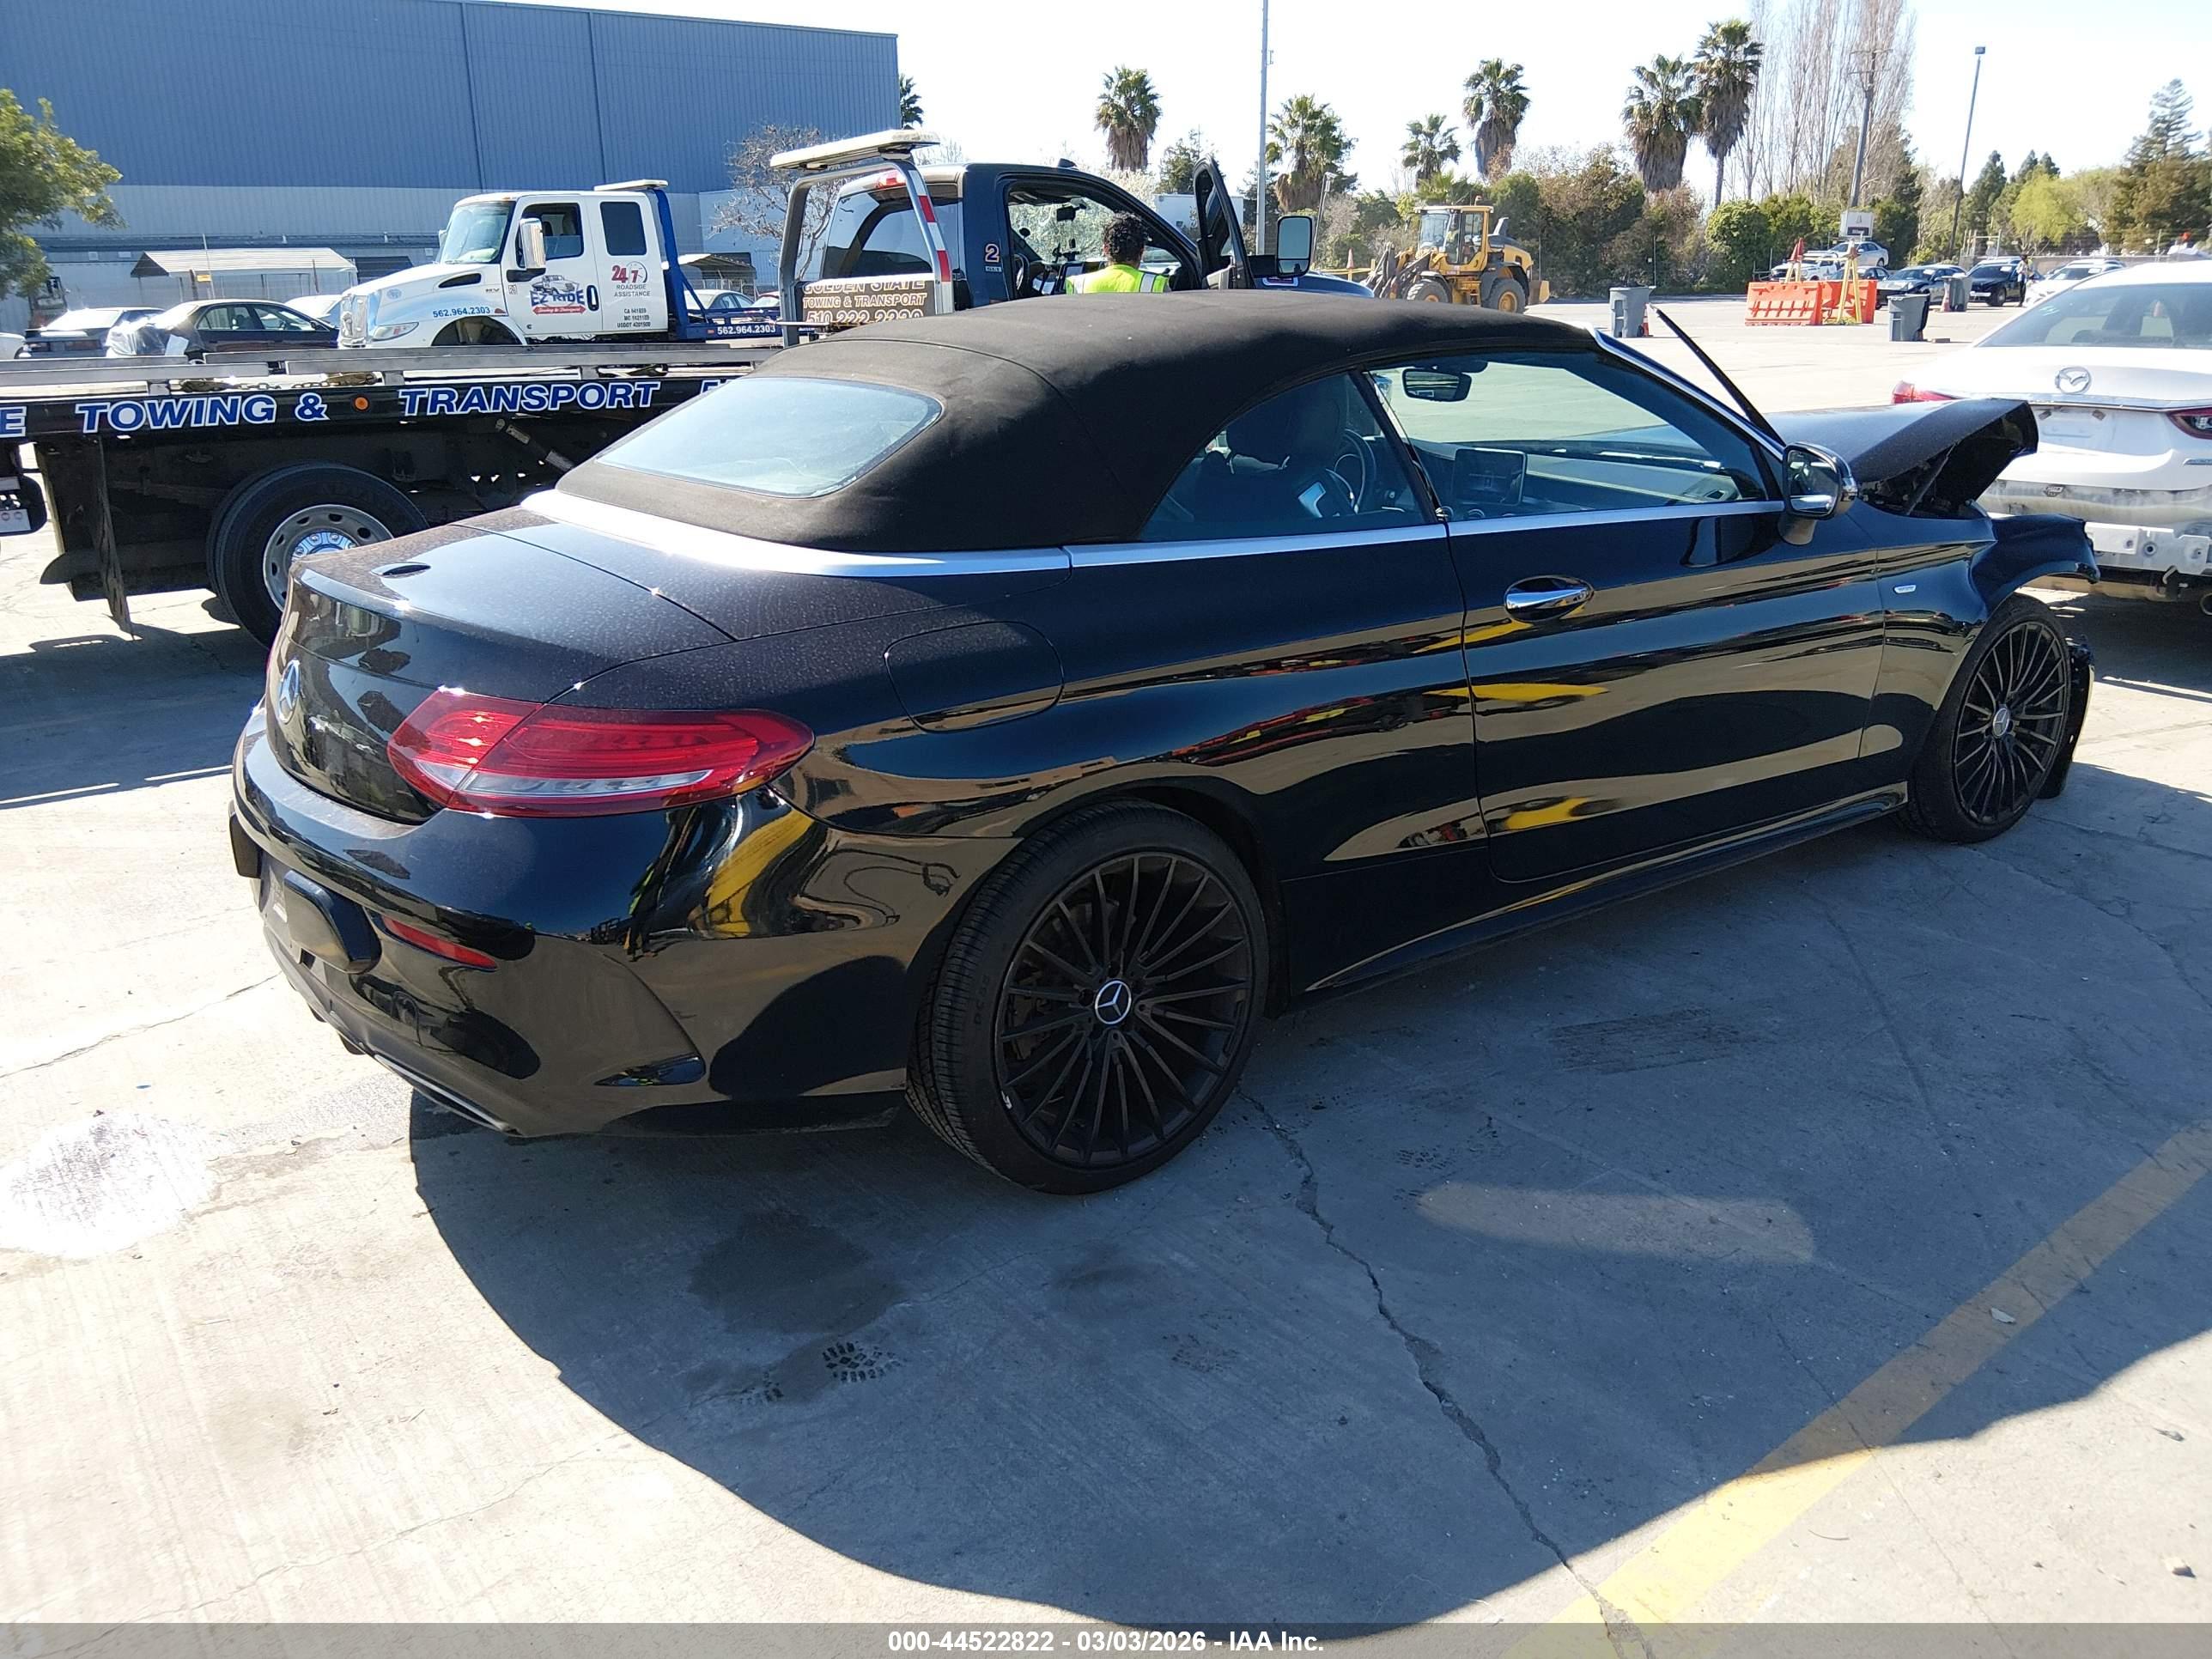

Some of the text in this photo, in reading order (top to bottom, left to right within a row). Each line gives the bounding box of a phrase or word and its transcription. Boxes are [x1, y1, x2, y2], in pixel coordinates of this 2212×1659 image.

[985, 243, 1000, 263] 2
[529, 289, 549, 307] EZ
[552, 289, 585, 305] RIDE
[802, 293, 927, 309] TOWING & TRANSPORT
[432, 306, 490, 318] 562.964.2303
[717, 325, 776, 335] 562.964.2303
[75, 394, 277, 434] TOWING
[295, 392, 331, 422] &
[398, 380, 660, 416] TRANSPORT
